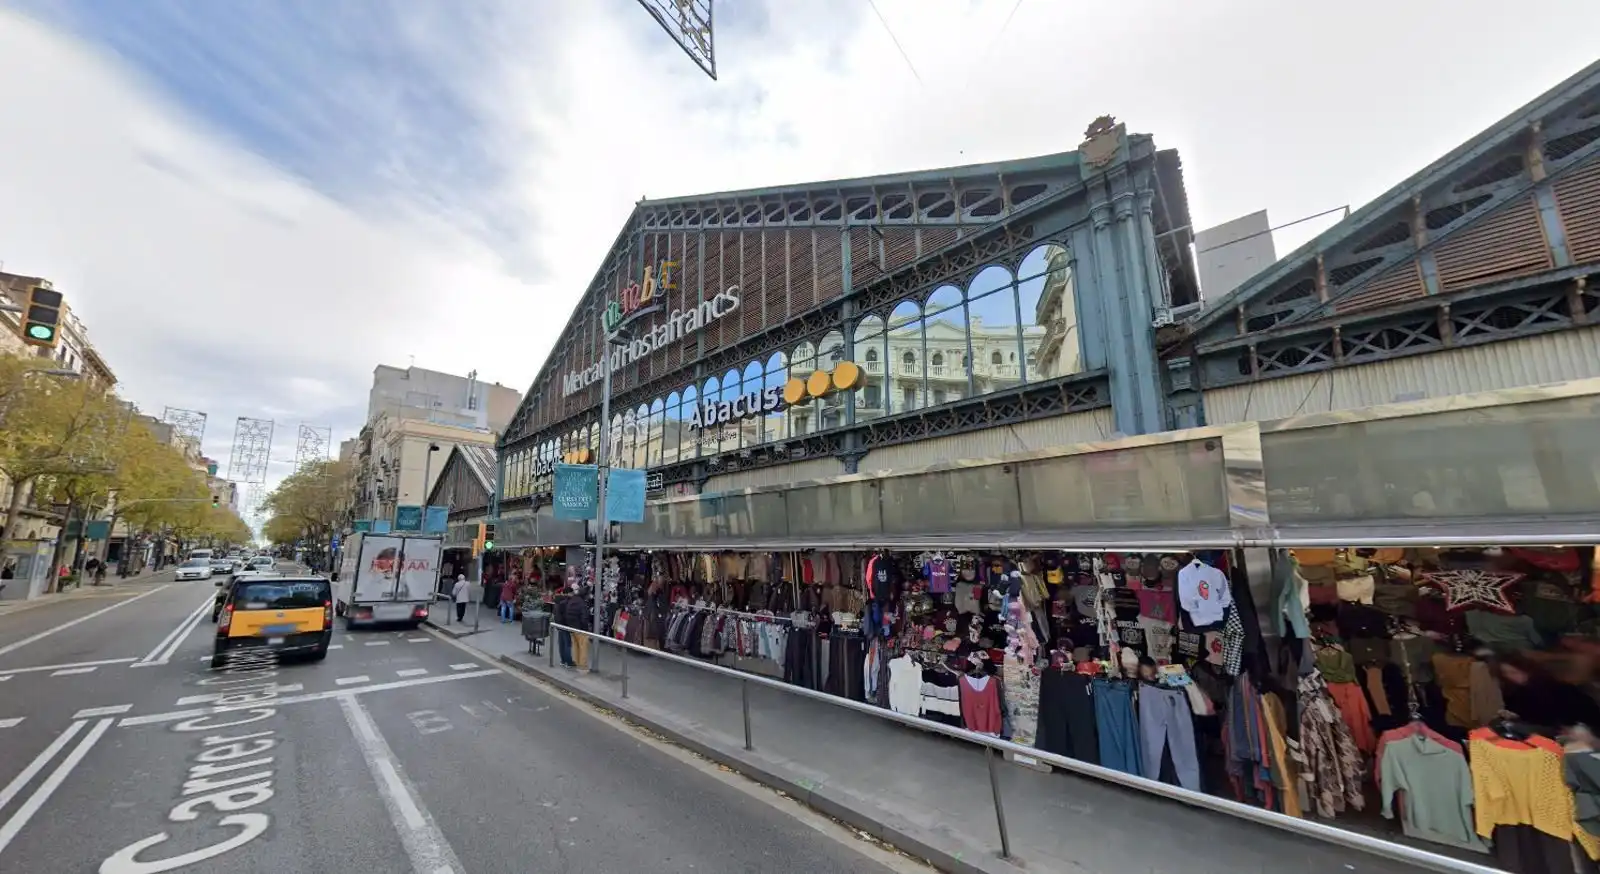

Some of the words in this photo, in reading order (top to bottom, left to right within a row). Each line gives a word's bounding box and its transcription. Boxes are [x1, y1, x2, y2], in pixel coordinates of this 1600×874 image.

[563, 355, 605, 398] Mercat
[611, 285, 740, 372] d'Hostafrancs
[688, 386, 780, 431] Abacus
